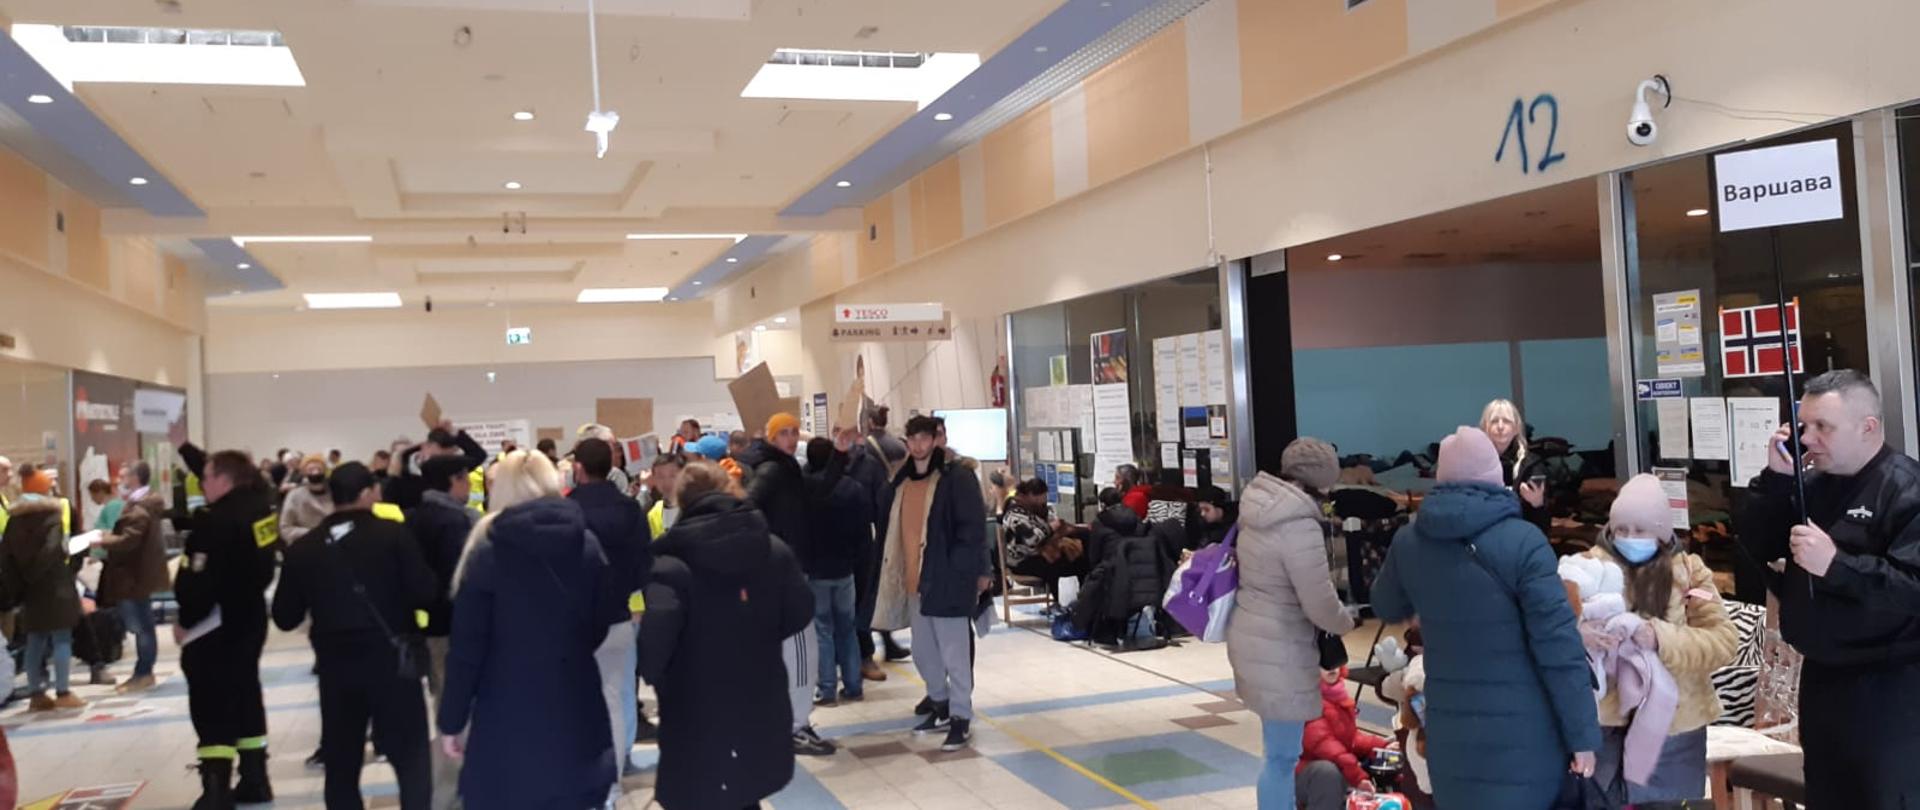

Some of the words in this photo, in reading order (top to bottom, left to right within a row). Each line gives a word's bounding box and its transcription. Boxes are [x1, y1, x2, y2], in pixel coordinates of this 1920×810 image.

[1495, 93, 1565, 174] 12
[1723, 175, 1832, 203] Варшава
[856, 309, 888, 318] TESCO
[841, 328, 881, 337] PARKING
